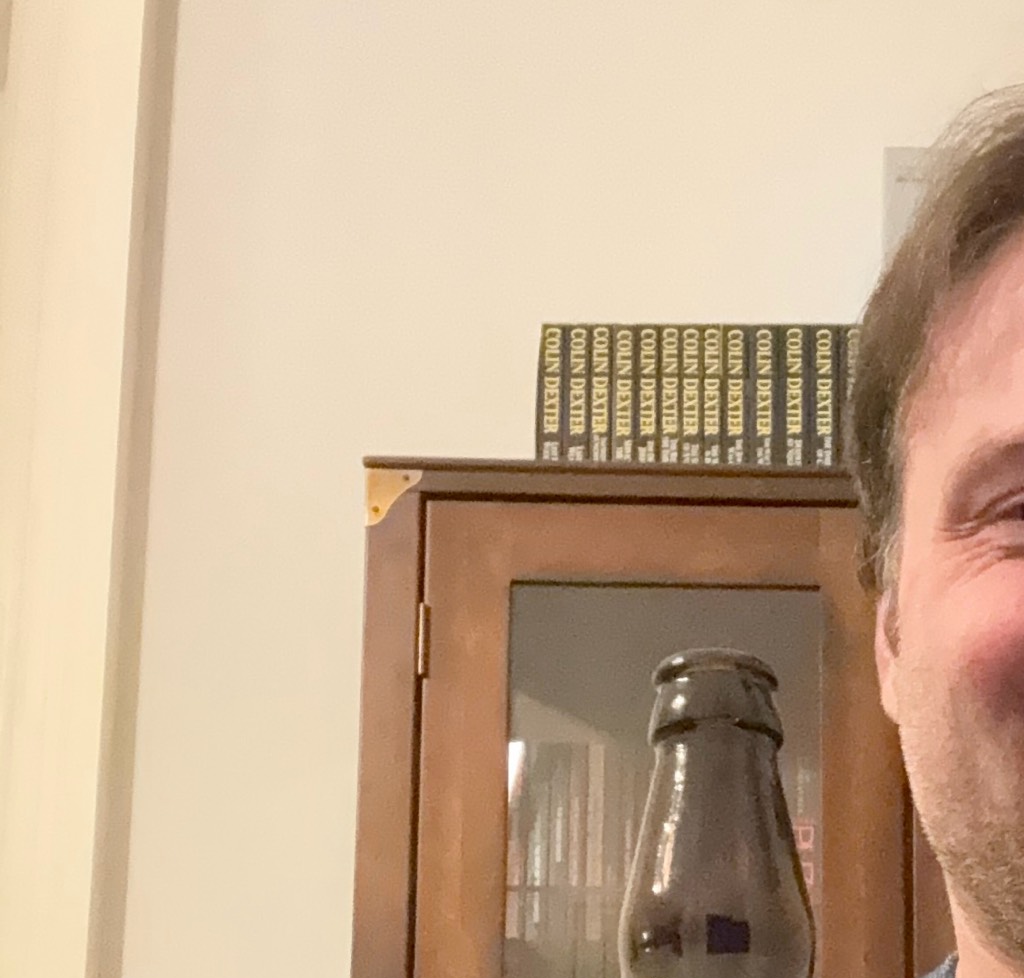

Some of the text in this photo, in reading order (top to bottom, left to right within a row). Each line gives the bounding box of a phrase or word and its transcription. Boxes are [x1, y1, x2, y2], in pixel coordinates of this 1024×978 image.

[545, 328, 562, 373] COLIN
[570, 329, 587, 374] COLIN
[593, 327, 609, 373] COLIN
[616, 330, 633, 375] COLIN
[640, 329, 656, 374] COLIN
[662, 328, 679, 373] COLIN
[683, 328, 699, 374] COLIN
[704, 329, 720, 374] COLIN
[727, 329, 744, 374] COLIN
[756, 329, 772, 375] COLIN
[786, 328, 803, 374] COLIN
[816, 329, 832, 374] COLIN
[543, 376, 561, 433] DEXTER
[569, 378, 586, 435] DEXTER
[592, 376, 608, 433] DEXTER
[616, 379, 633, 436] DEXTER
[640, 378, 656, 435] DEXTER
[662, 377, 679, 434] DEXTER
[683, 378, 699, 435] DEXTER
[704, 378, 720, 436] DEXTER
[727, 378, 744, 437] DEXTER
[756, 378, 772, 437] DEXTER
[786, 378, 803, 436] DEXTER
[816, 378, 833, 436] DEXTER
